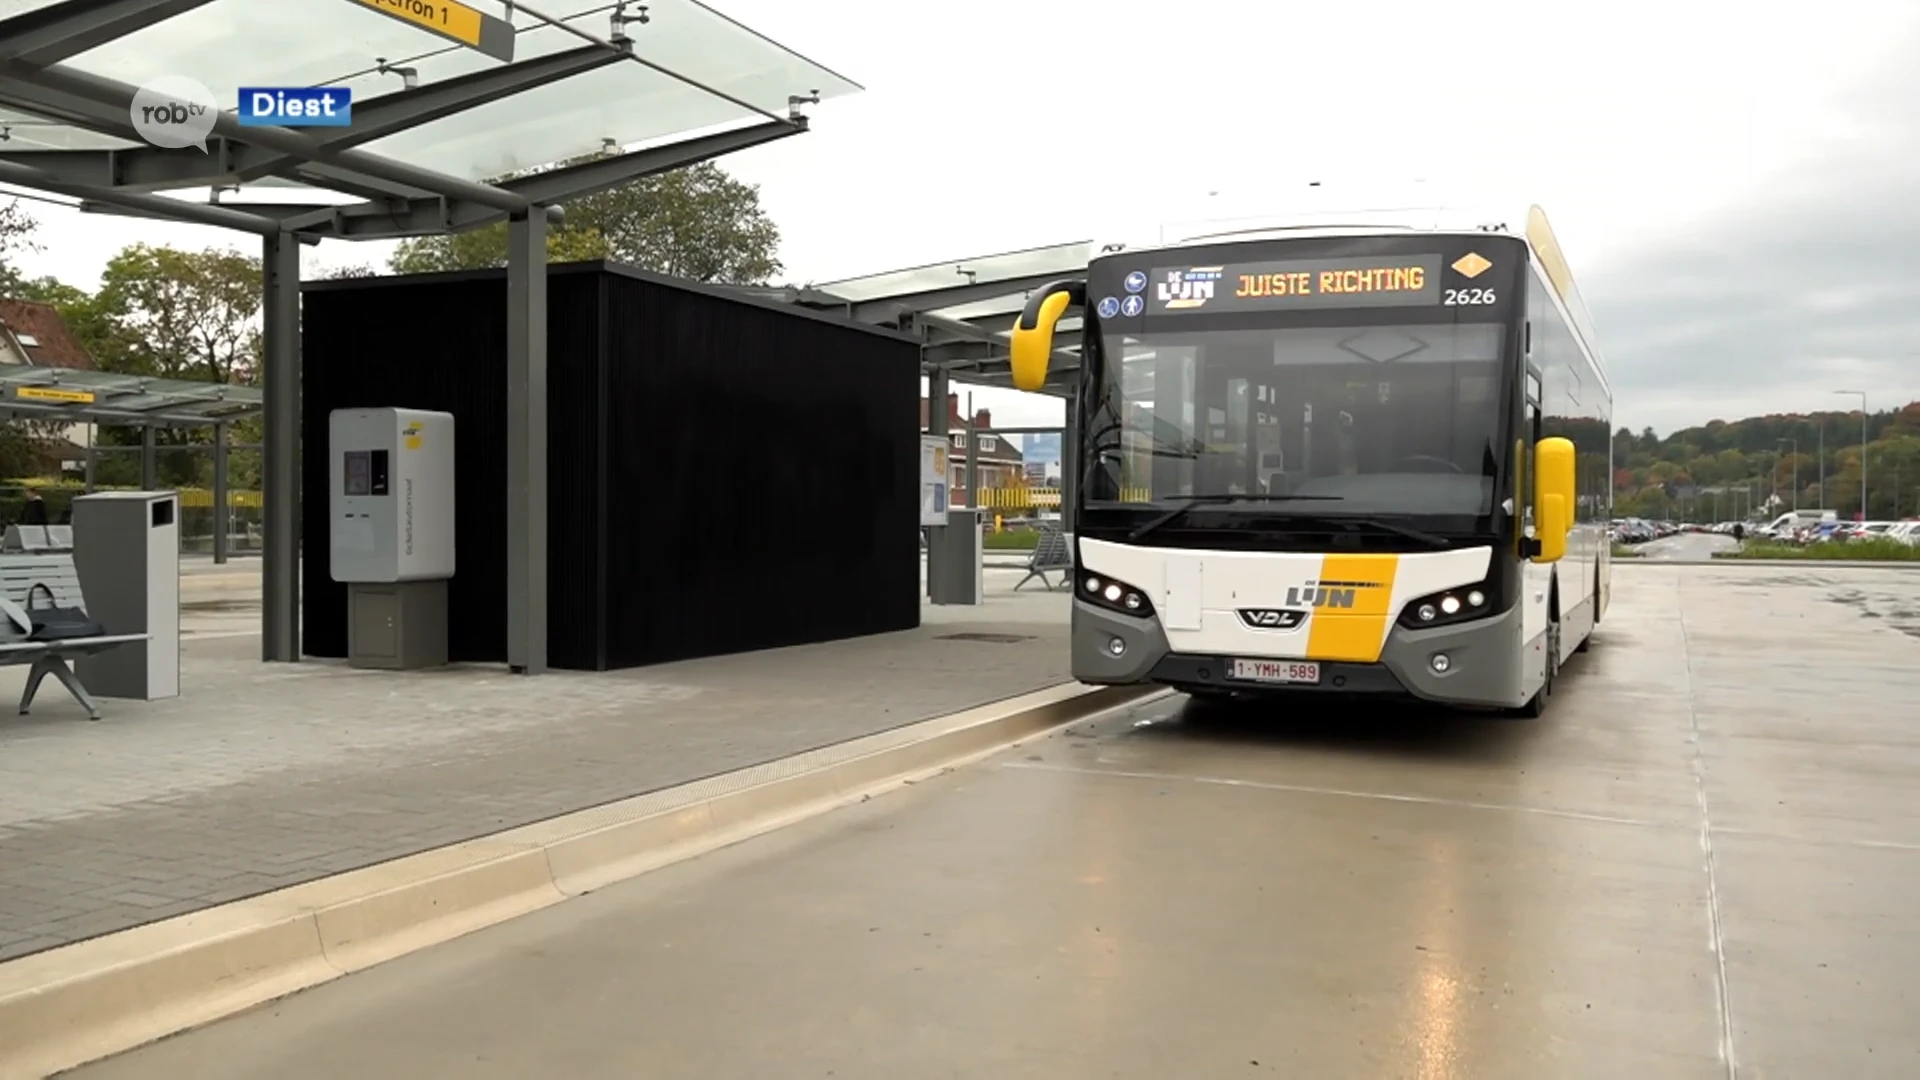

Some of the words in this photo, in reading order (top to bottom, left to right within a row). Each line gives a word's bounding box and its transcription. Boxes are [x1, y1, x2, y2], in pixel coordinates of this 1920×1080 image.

[441, 7, 448, 24] 1
[1236, 273, 1310, 296] JUISTE
[1319, 267, 1424, 293] RICHTING
[1444, 288, 1496, 305] 2626
[1247, 611, 1294, 624] VDL
